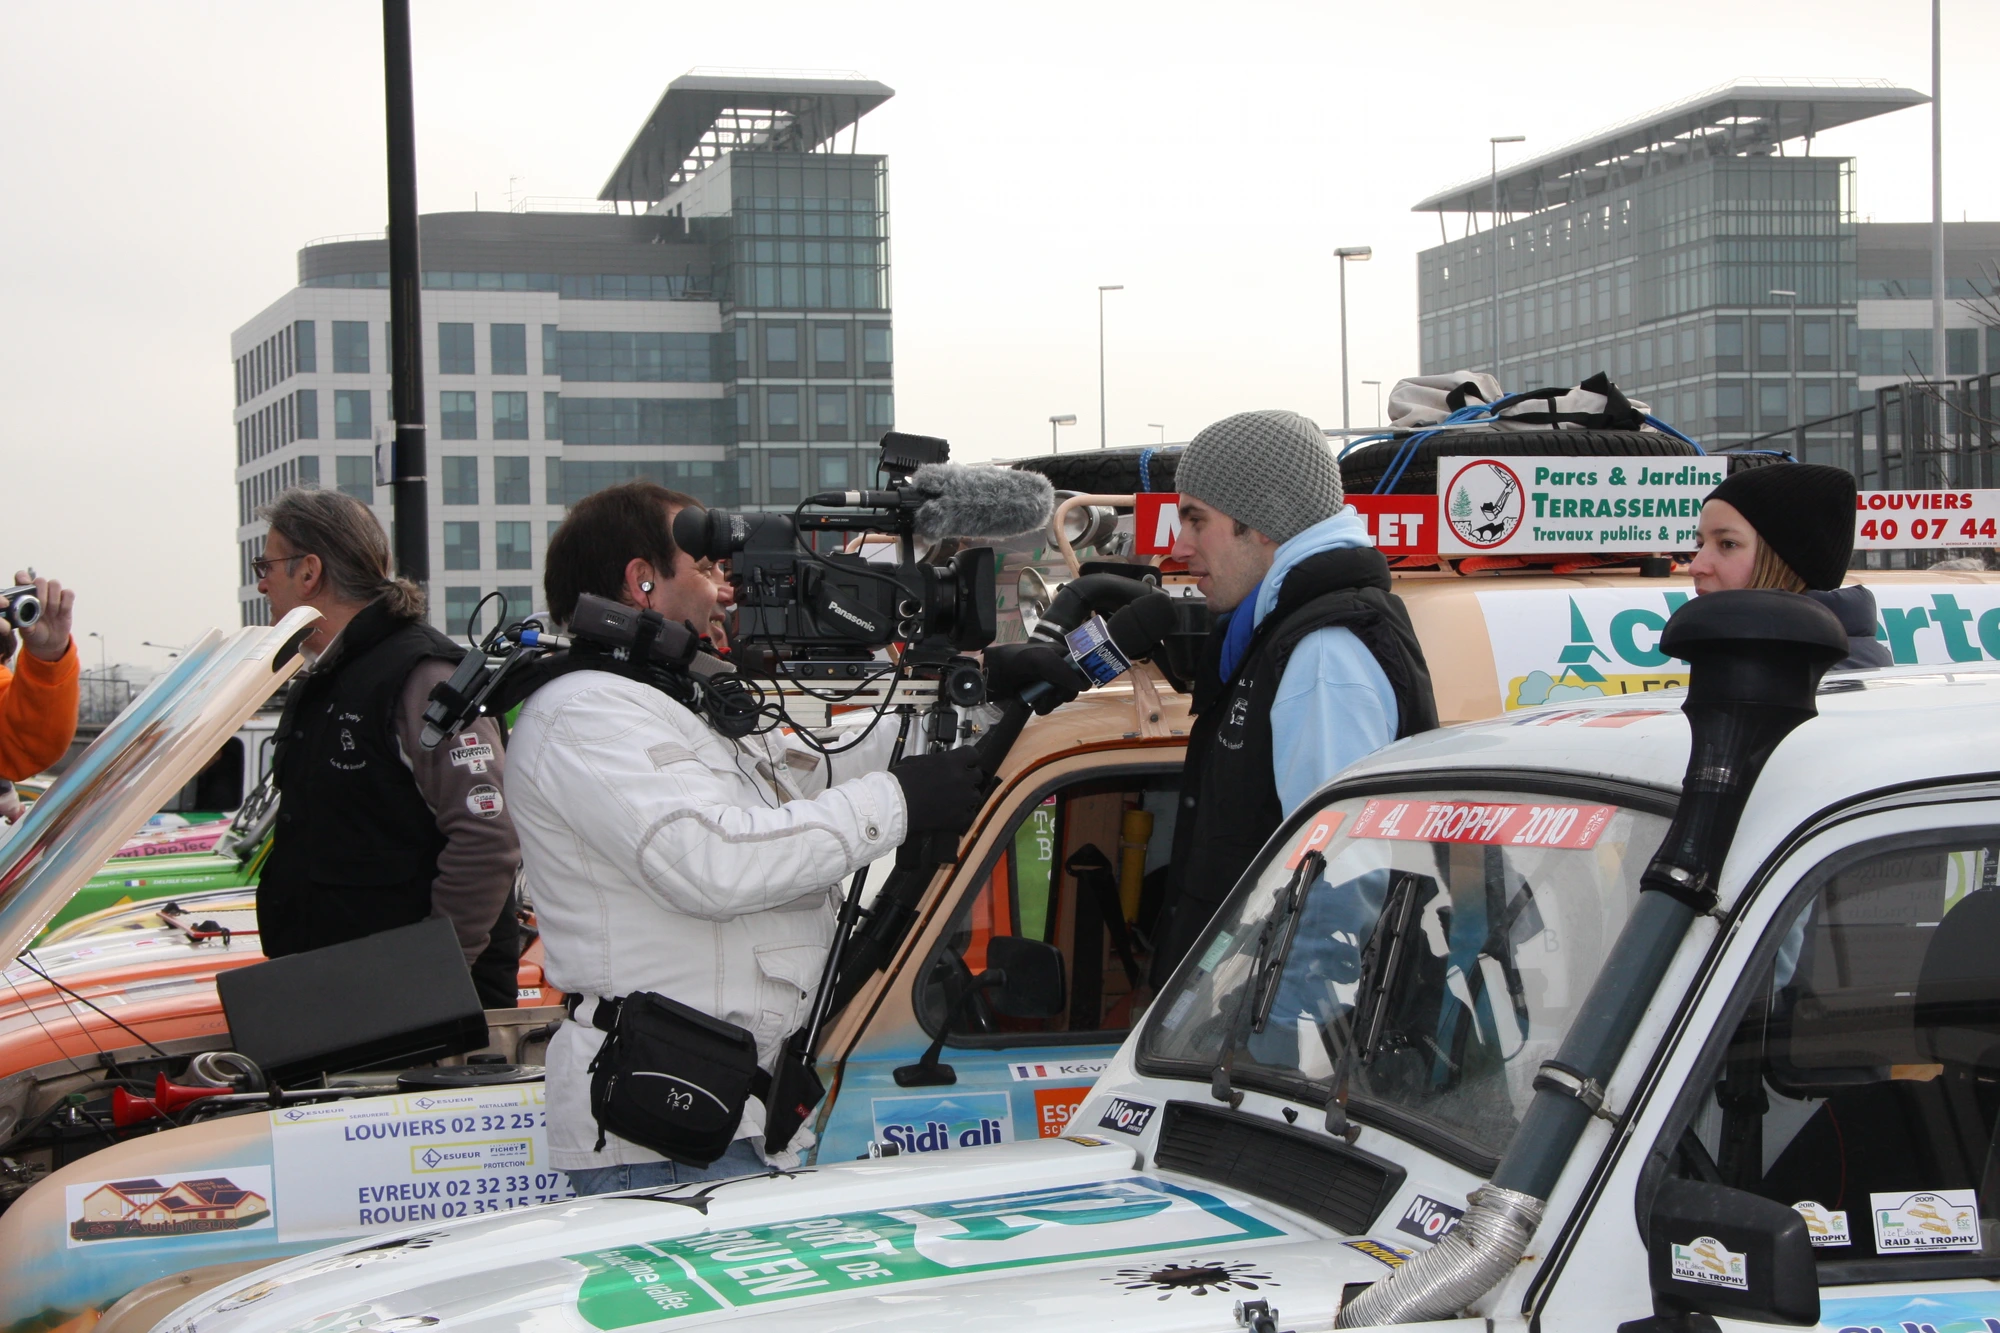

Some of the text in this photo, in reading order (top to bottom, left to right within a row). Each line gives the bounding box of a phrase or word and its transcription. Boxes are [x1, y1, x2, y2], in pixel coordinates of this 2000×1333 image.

[1534, 466, 1722, 486] Parcs & Jardins
[1532, 492, 1704, 518] TERRASSEMEN
[1856, 493, 1973, 510] LOUVIERS
[1533, 525, 1697, 544] Travaux publics & pri
[1860, 518, 1997, 540] 40 07 44
[828, 601, 875, 632] Panasonic
[1083, 652, 1117, 683] WEB
[1093, 677, 1104, 687] TV
[451, 748, 491, 760] NORWAY
[1378, 804, 1410, 836] 4L
[1415, 805, 1516, 841] TROPHY
[1512, 806, 1579, 844] 2010
[1036, 837, 1053, 860] B
[1300, 823, 1329, 857] P
[113, 849, 139, 858] ort
[1105, 1100, 1150, 1128] Niort
[344, 1111, 547, 1141] LOUVIERS 02 32 25 2
[882, 1118, 1002, 1153] Sidi ali
[483, 1160, 526, 1170] PROTECTION
[359, 1181, 441, 1203] EVREUX
[446, 1179, 471, 1197] 02
[476, 1177, 500, 1194] 32
[506, 1175, 529, 1192] 33
[535, 1173, 558, 1190] 07
[359, 1203, 436, 1225] ROUEN
[442, 1201, 467, 1218] 02
[1405, 1197, 1460, 1236] Nior
[71, 1217, 239, 1237] Les Authieux
[1809, 1234, 1847, 1242] TROPHY
[1700, 1237, 1716, 1245] 2010
[1884, 1235, 1974, 1246] RAID 4L TROPHY
[836, 1260, 894, 1281] DE
[1675, 1267, 1695, 1277] RAID
[1697, 1271, 1707, 1279] 4L
[1709, 1273, 1744, 1284] TROPHY
[642, 1283, 693, 1311] vallée
